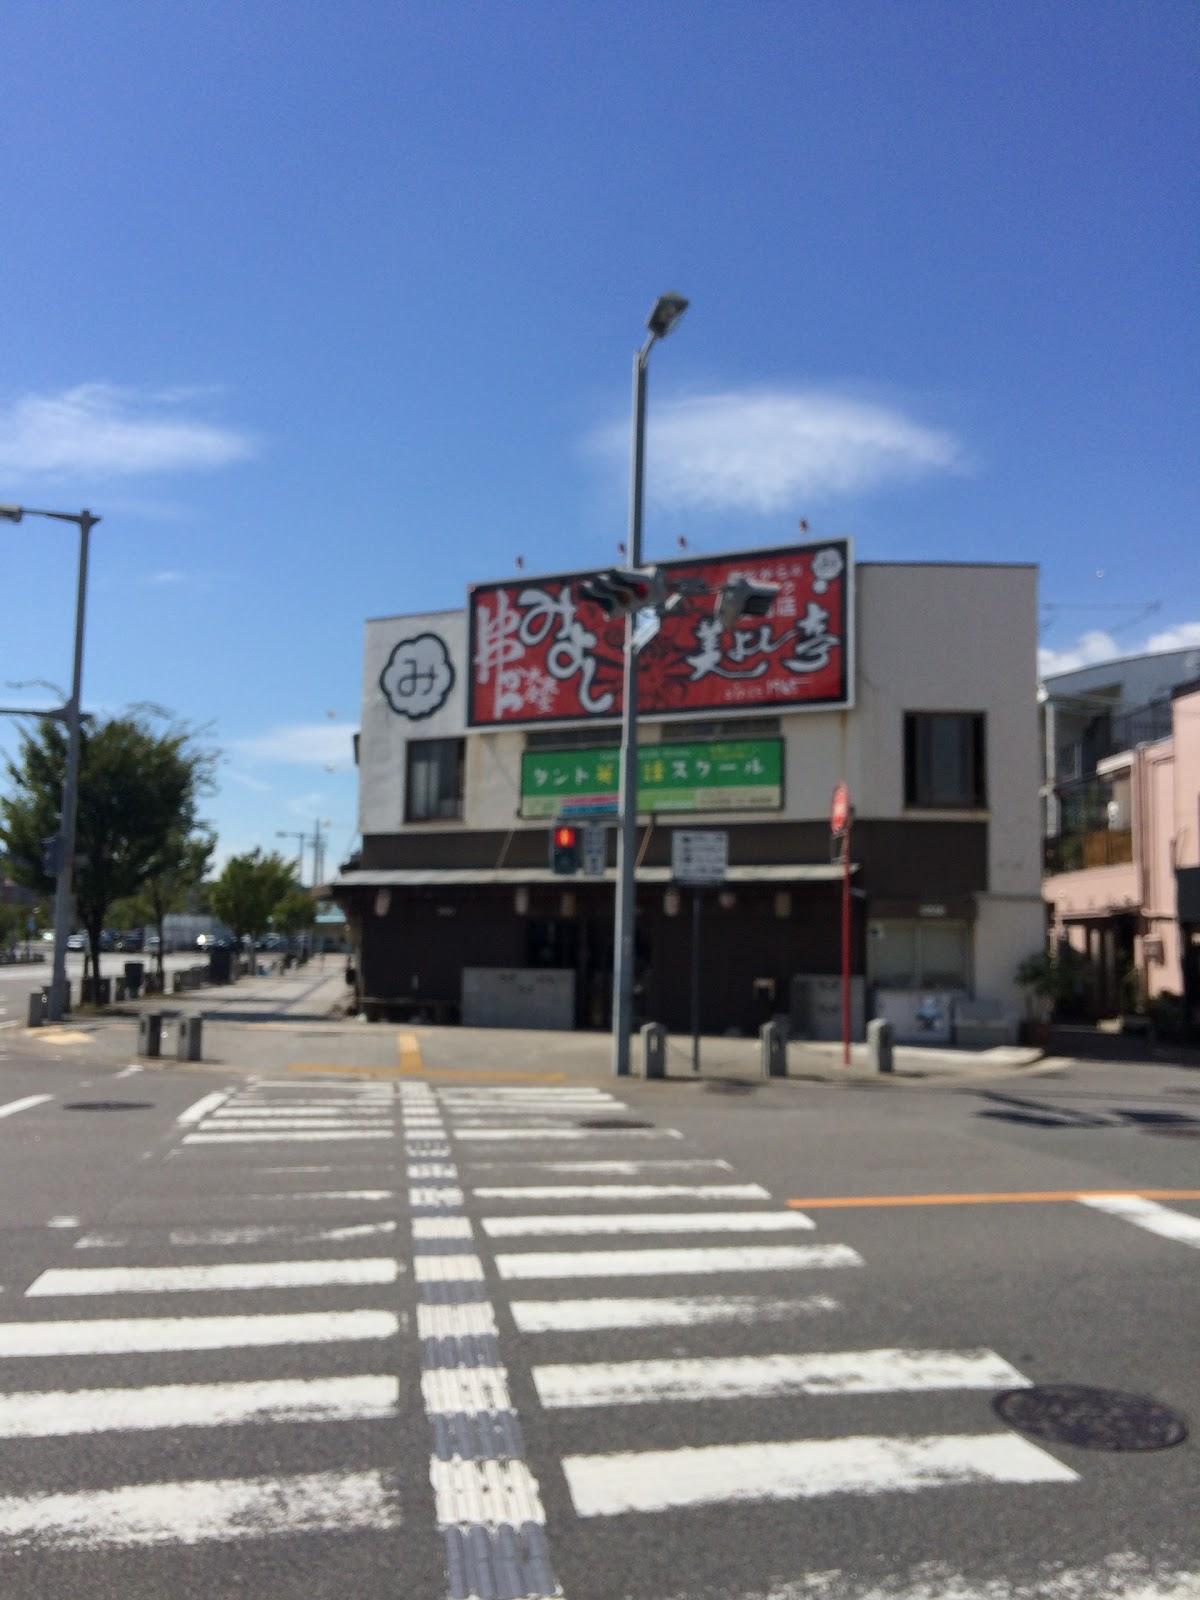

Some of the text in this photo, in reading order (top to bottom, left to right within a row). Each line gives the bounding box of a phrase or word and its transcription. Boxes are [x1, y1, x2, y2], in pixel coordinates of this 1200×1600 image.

[517, 586, 614, 713] みよし
[398, 658, 440, 697] み
[533, 756, 765, 786] タント英話スクール
